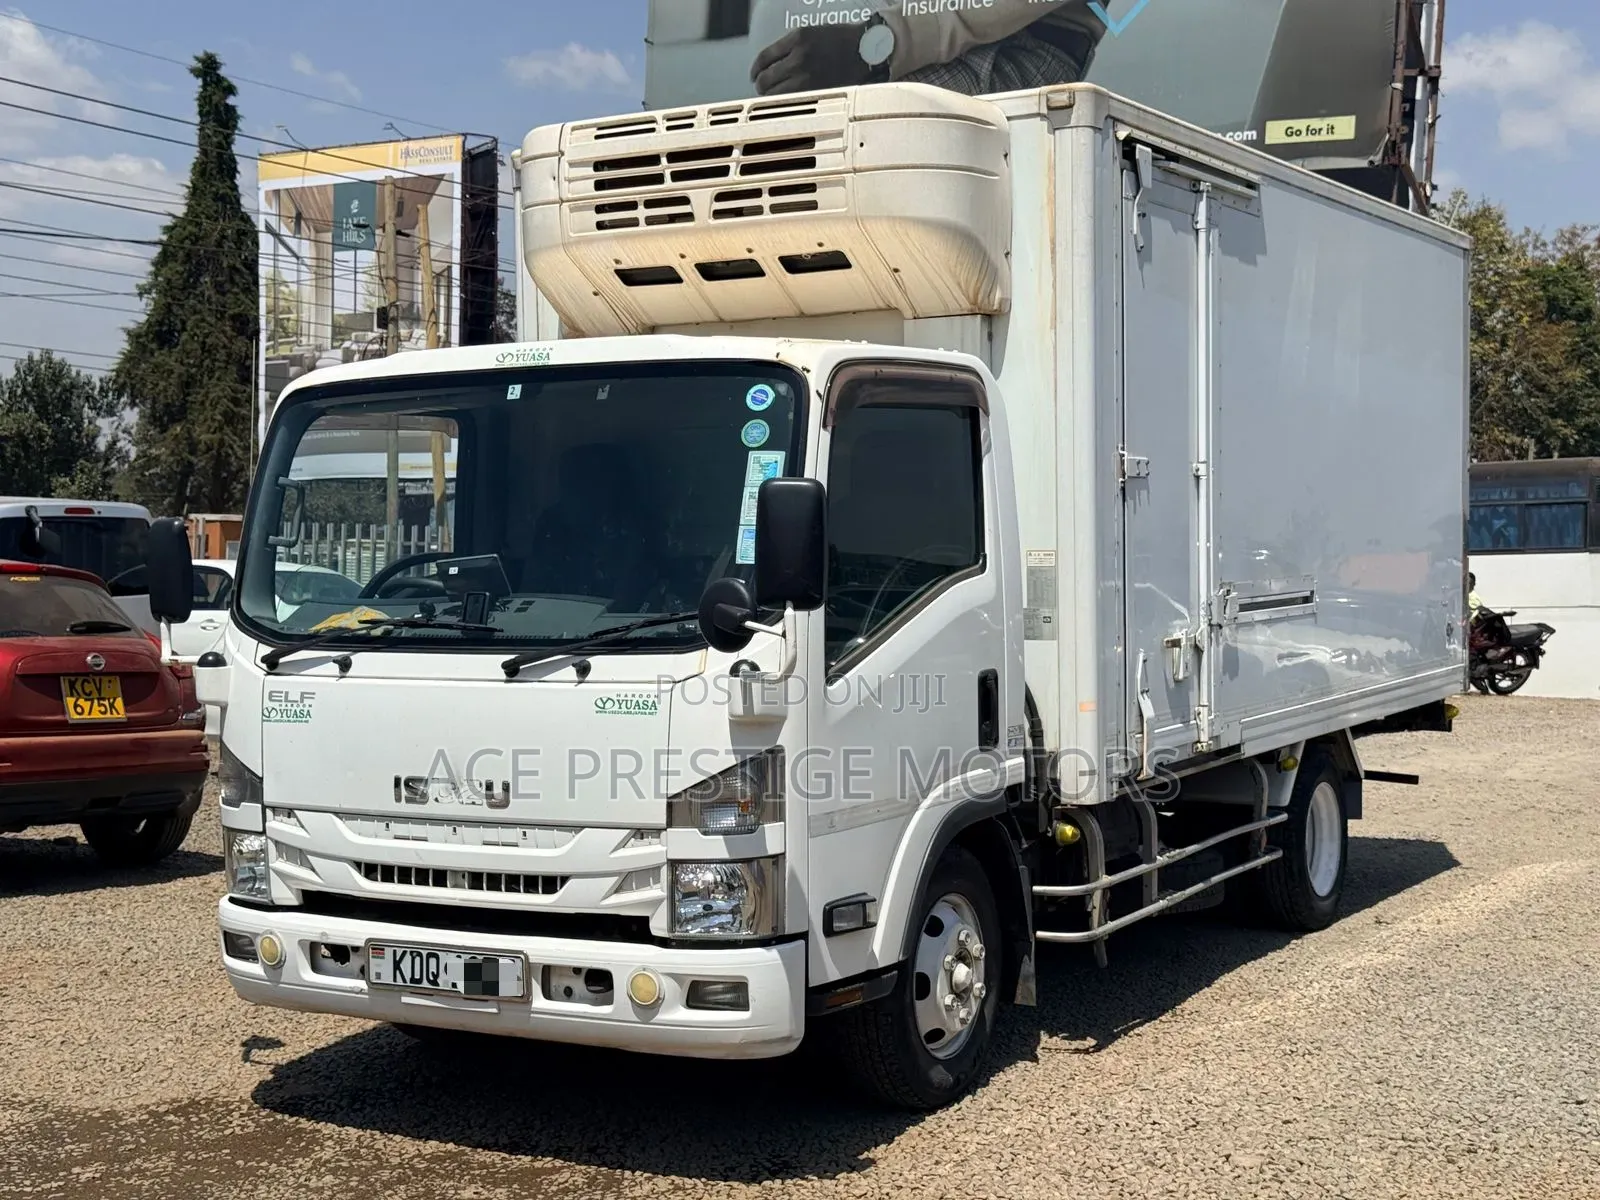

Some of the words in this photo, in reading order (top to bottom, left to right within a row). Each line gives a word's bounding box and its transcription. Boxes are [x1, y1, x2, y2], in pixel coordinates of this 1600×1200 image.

[785, 7, 872, 29] Insurance
[1285, 126, 1302, 138] Go
[1305, 125, 1323, 136] for
[1326, 124, 1335, 135] it
[515, 352, 551, 362] YUASA
[68, 677, 102, 698] KCV
[268, 690, 316, 704] ELF
[73, 697, 120, 716] 675K
[616, 699, 658, 710] YUASA
[279, 708, 312, 719] YUASA
[392, 949, 441, 986] KDQ
